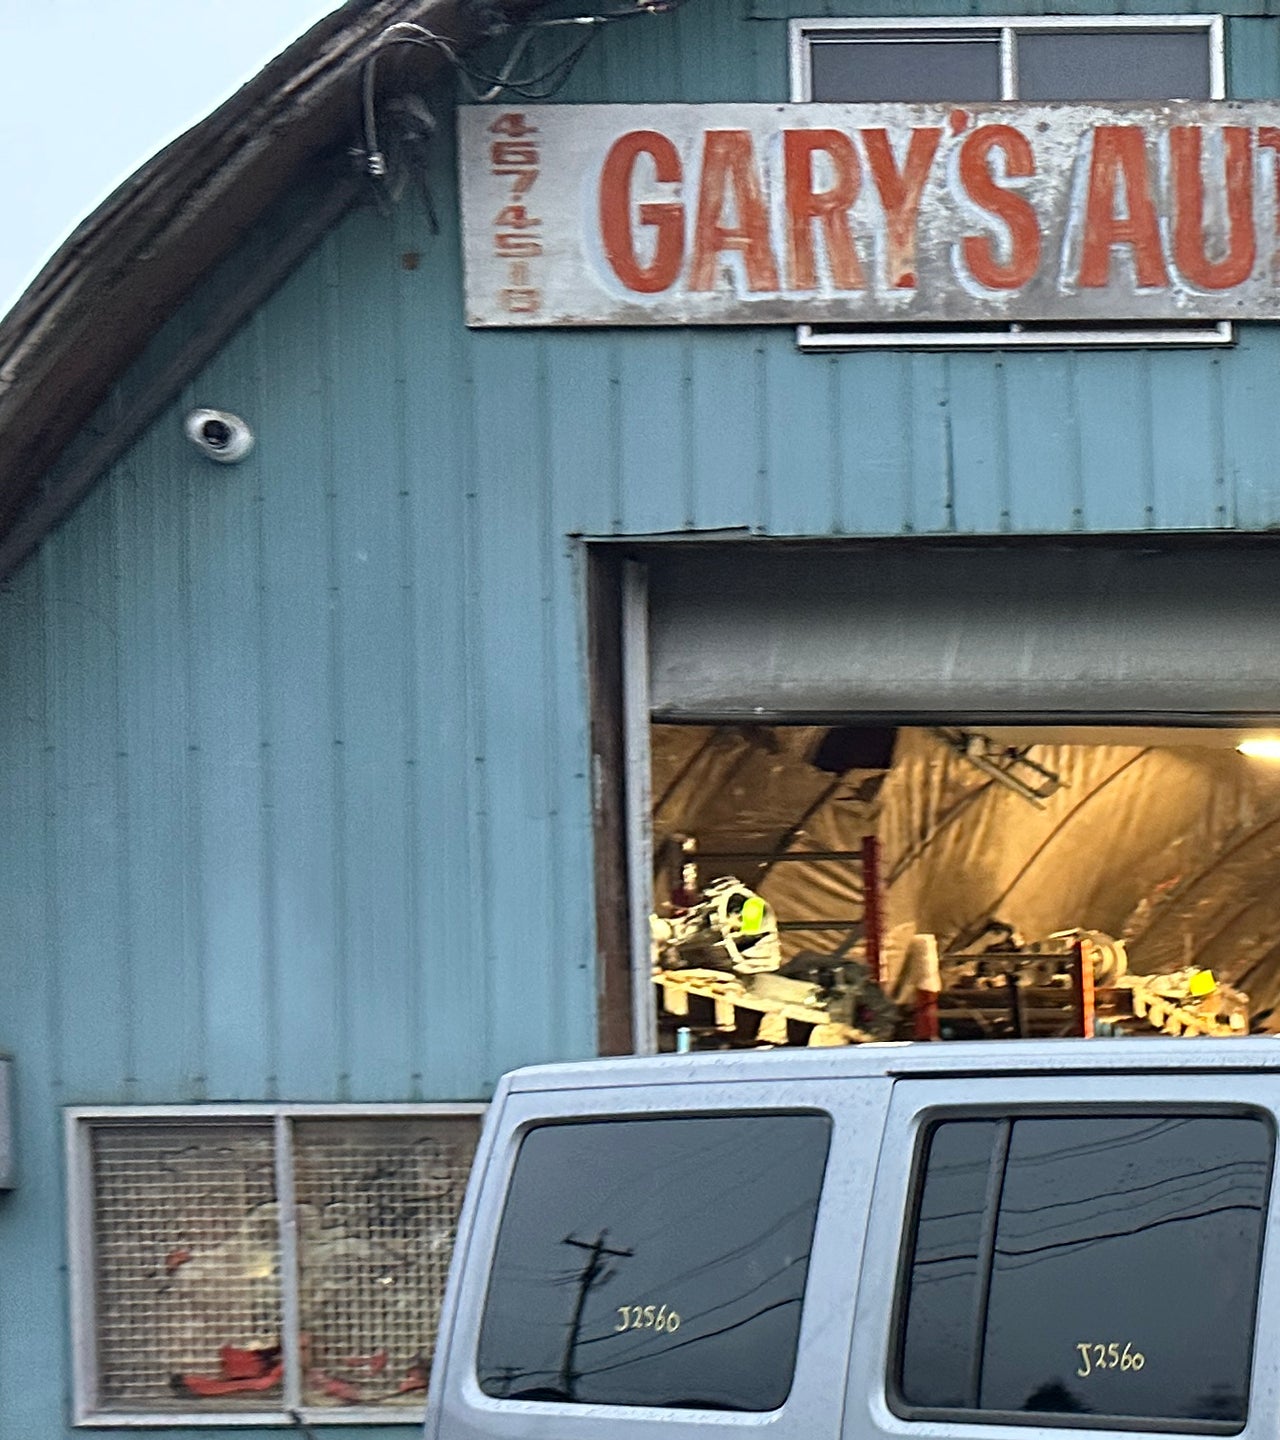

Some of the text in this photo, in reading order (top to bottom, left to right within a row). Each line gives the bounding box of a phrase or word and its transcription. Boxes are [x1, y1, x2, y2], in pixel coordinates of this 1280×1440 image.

[600, 108, 1042, 295] GARY'S
[614, 1302, 681, 1334] J2560
[1075, 1341, 1146, 1378] J2560
